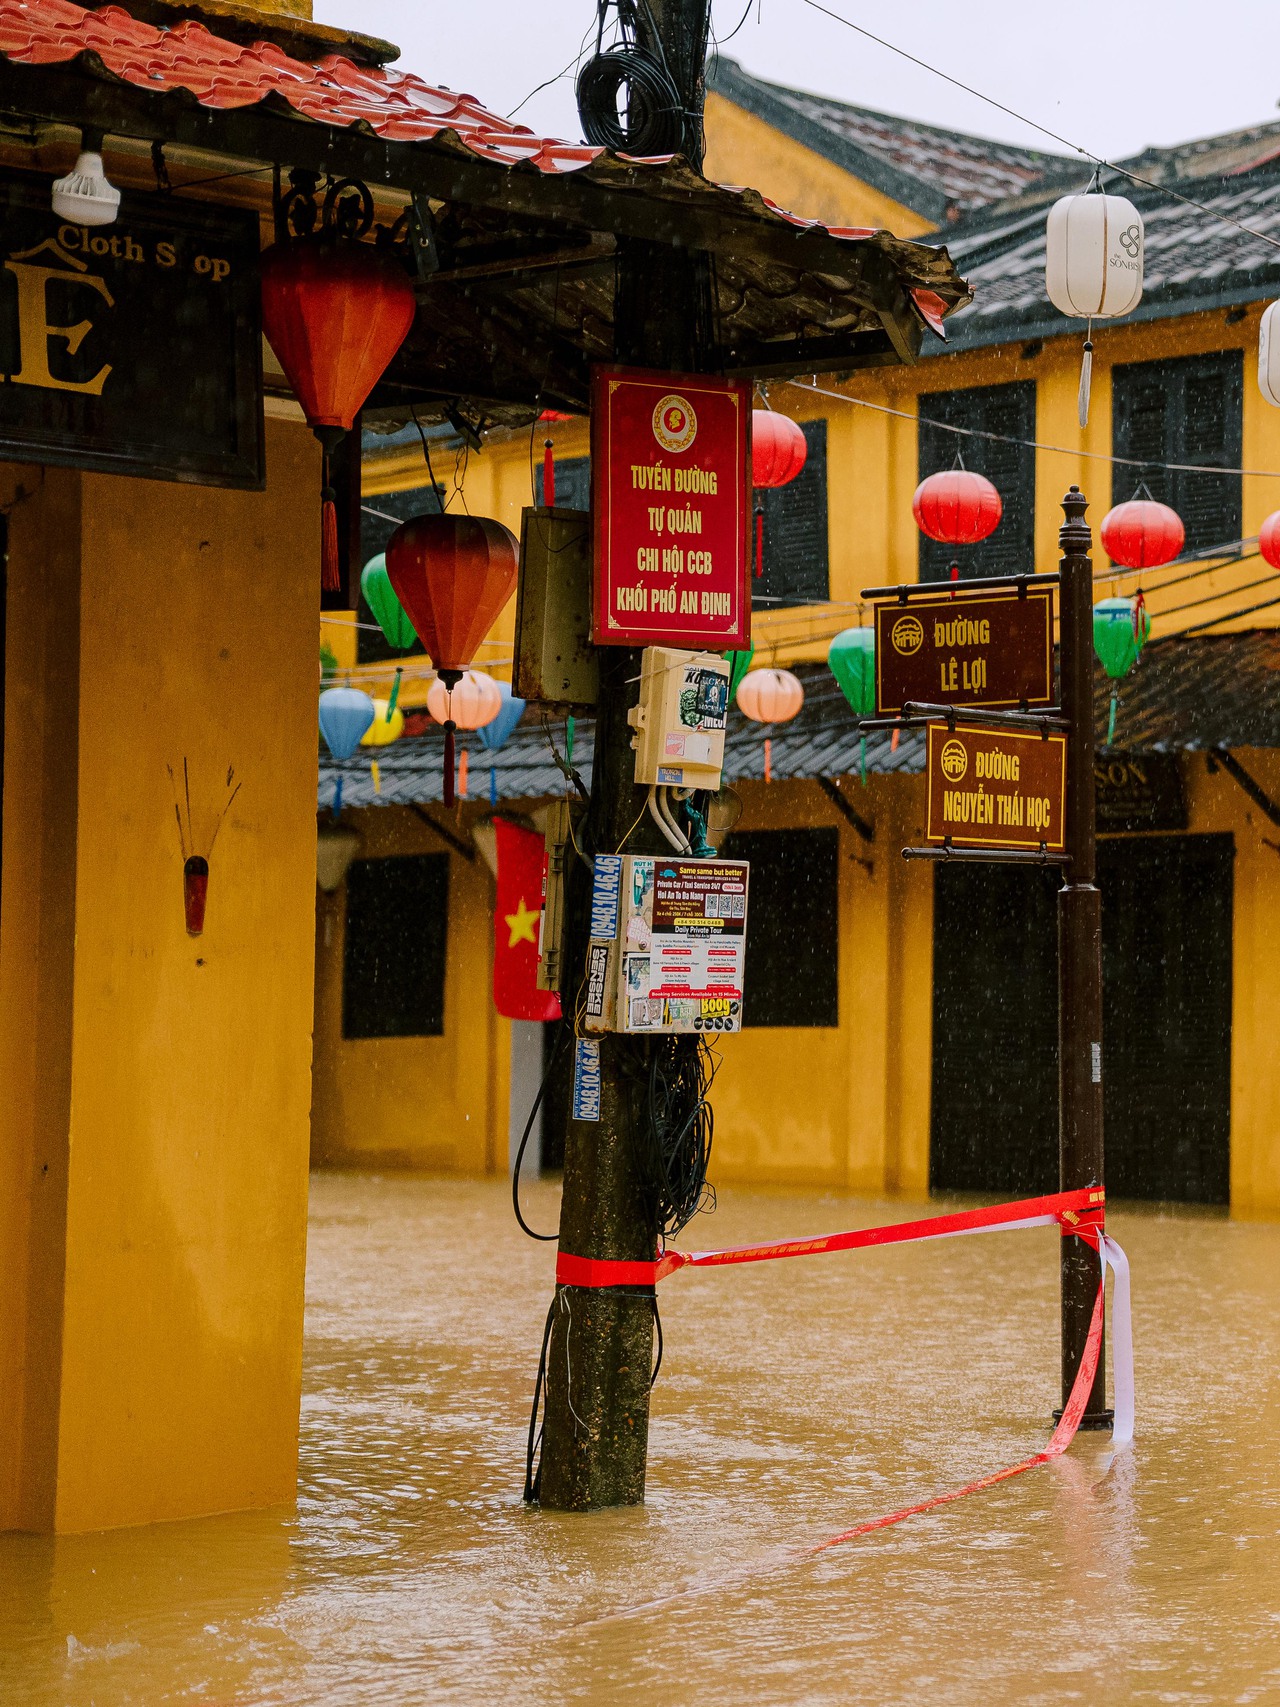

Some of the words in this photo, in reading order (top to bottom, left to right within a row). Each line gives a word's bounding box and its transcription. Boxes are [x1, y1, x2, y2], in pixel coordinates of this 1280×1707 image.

[57, 224, 146, 264] Cloth
[155, 240, 231, 283] Sop
[631, 460, 671, 491] TUYẾN
[674, 464, 718, 495] ĐƯỜNG
[648, 506, 665, 537] TỰ
[667, 502, 702, 534] QUẢN
[637, 547, 659, 572] CHI
[662, 544, 684, 578] HỘI
[687, 550, 713, 575] CCB
[617, 580, 648, 612] KHỐI
[651, 581, 677, 613] PHỐ
[679, 590, 698, 615] AN
[701, 591, 731, 620] ĐỊNH
[934, 615, 990, 648] ĐƯỜNG
[940, 657, 958, 692] LÊ
[963, 657, 987, 694] LỢI
[976, 746, 1020, 782] ĐƯỜNG
[943, 783, 993, 825] NGUYỄN
[997, 792, 1024, 827] THÁI
[1027, 796, 1050, 832] HỌC
[657, 880, 672, 888] Private
[679, 866, 697, 874] Same
[714, 868, 724, 876] but
[724, 868, 743, 876] better
[591, 857, 621, 937] 0948.10.46.46
[675, 892, 682, 900] To
[682, 892, 689, 900] Da
[690, 892, 704, 901] Nang
[675, 926, 689, 934] Daily
[586, 948, 600, 1014] SENSEE
[594, 948, 608, 1014] MERSKE
